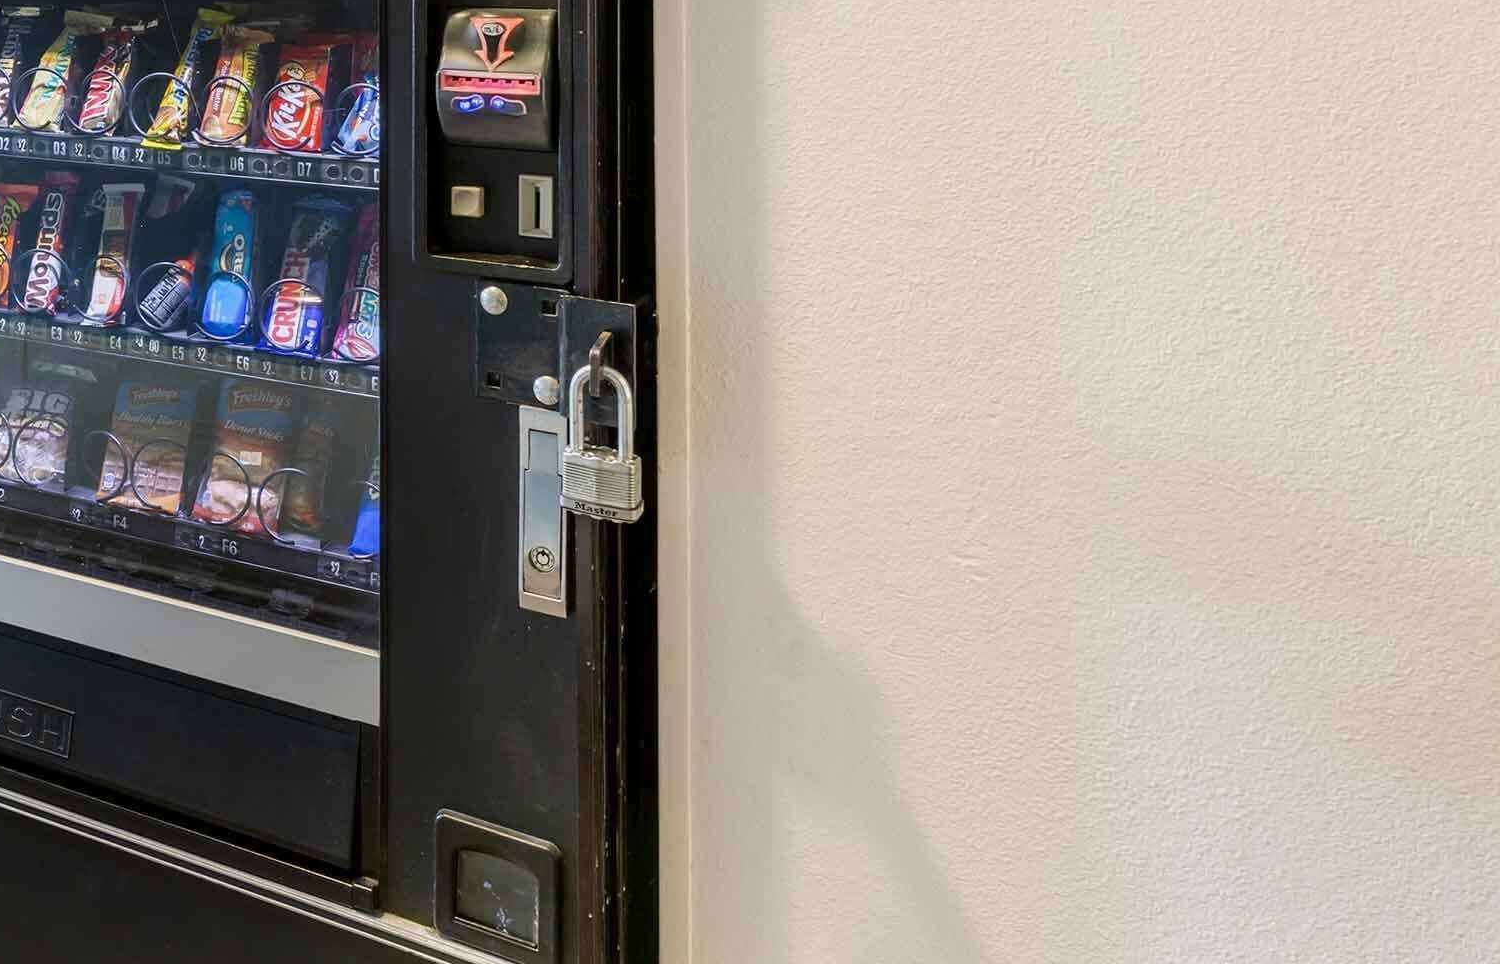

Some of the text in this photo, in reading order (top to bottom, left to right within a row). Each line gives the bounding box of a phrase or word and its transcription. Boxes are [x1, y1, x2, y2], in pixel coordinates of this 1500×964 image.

[271, 246, 310, 343] CRUNCH
[51, 327, 62, 341] E3
[109, 336, 122, 349] E4
[172, 345, 185, 360] E5
[236, 356, 250, 372] E6
[301, 365, 314, 381] E7
[573, 500, 619, 518] Master
[112, 514, 128, 530] F4
[222, 538, 238, 555] F6
